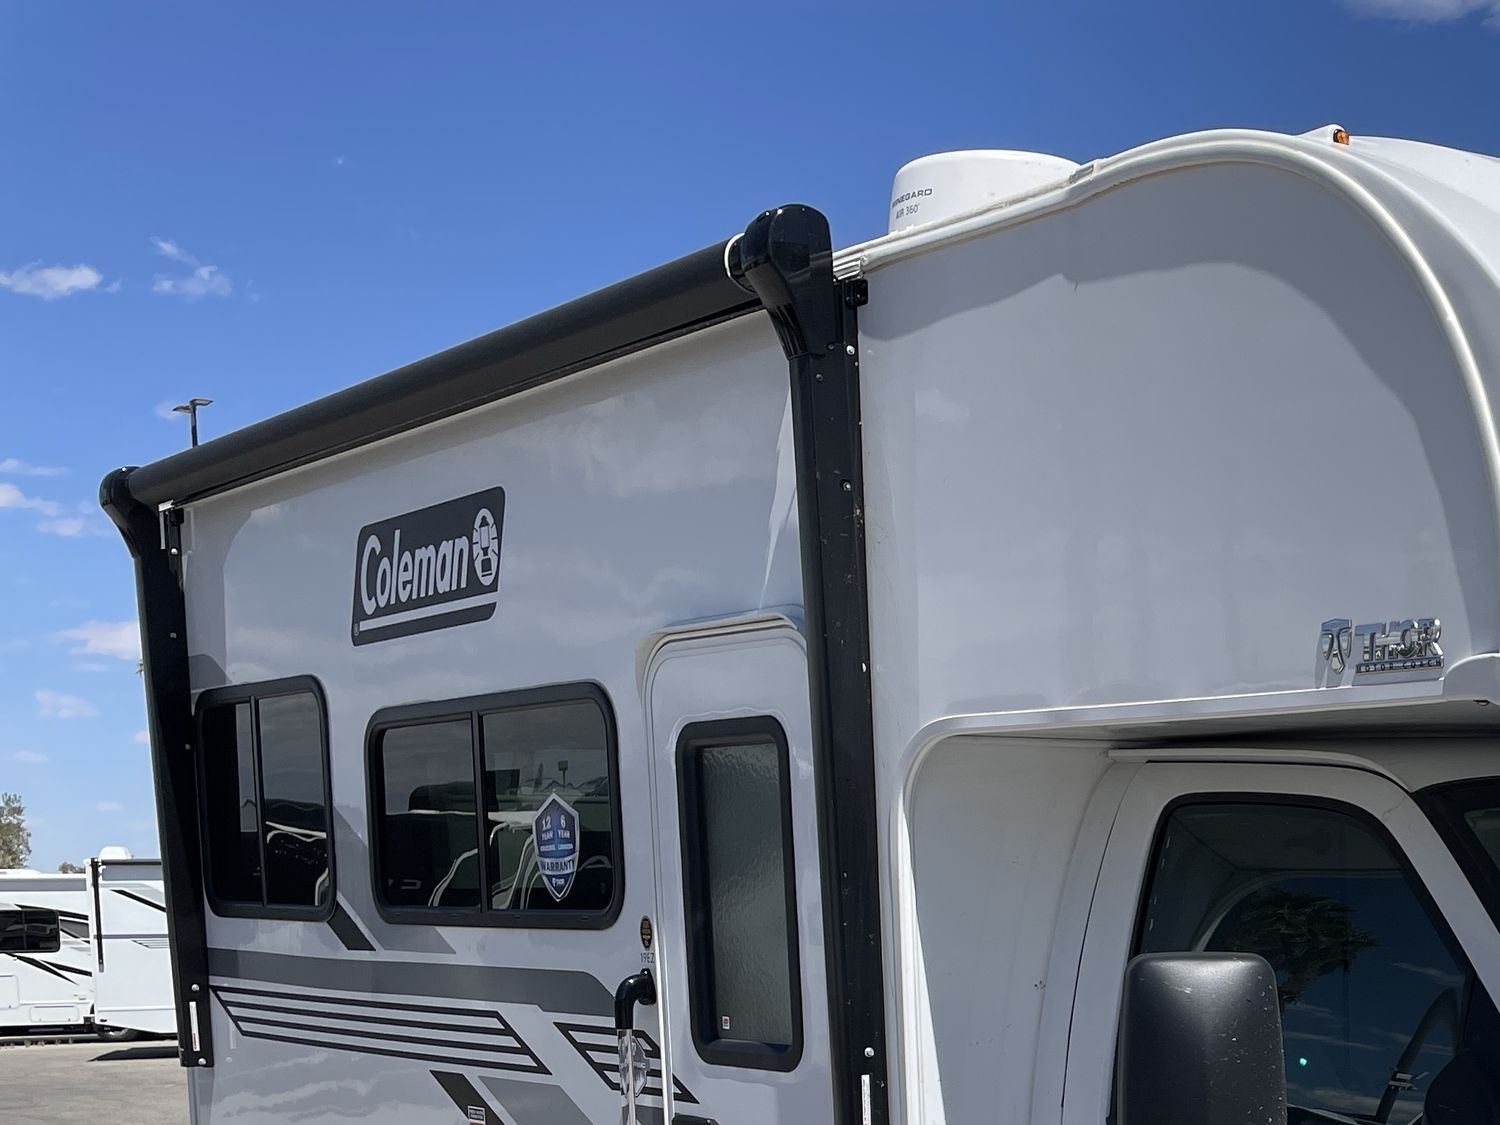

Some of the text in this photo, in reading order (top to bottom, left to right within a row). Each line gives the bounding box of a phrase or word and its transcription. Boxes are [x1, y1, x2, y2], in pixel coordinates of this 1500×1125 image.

[905, 204, 919, 216] 360
[360, 528, 470, 616] Coleman
[541, 814, 566, 831] 12 6
[541, 829, 571, 841] YEAR YEAR
[540, 859, 576, 873] WARRANTY
